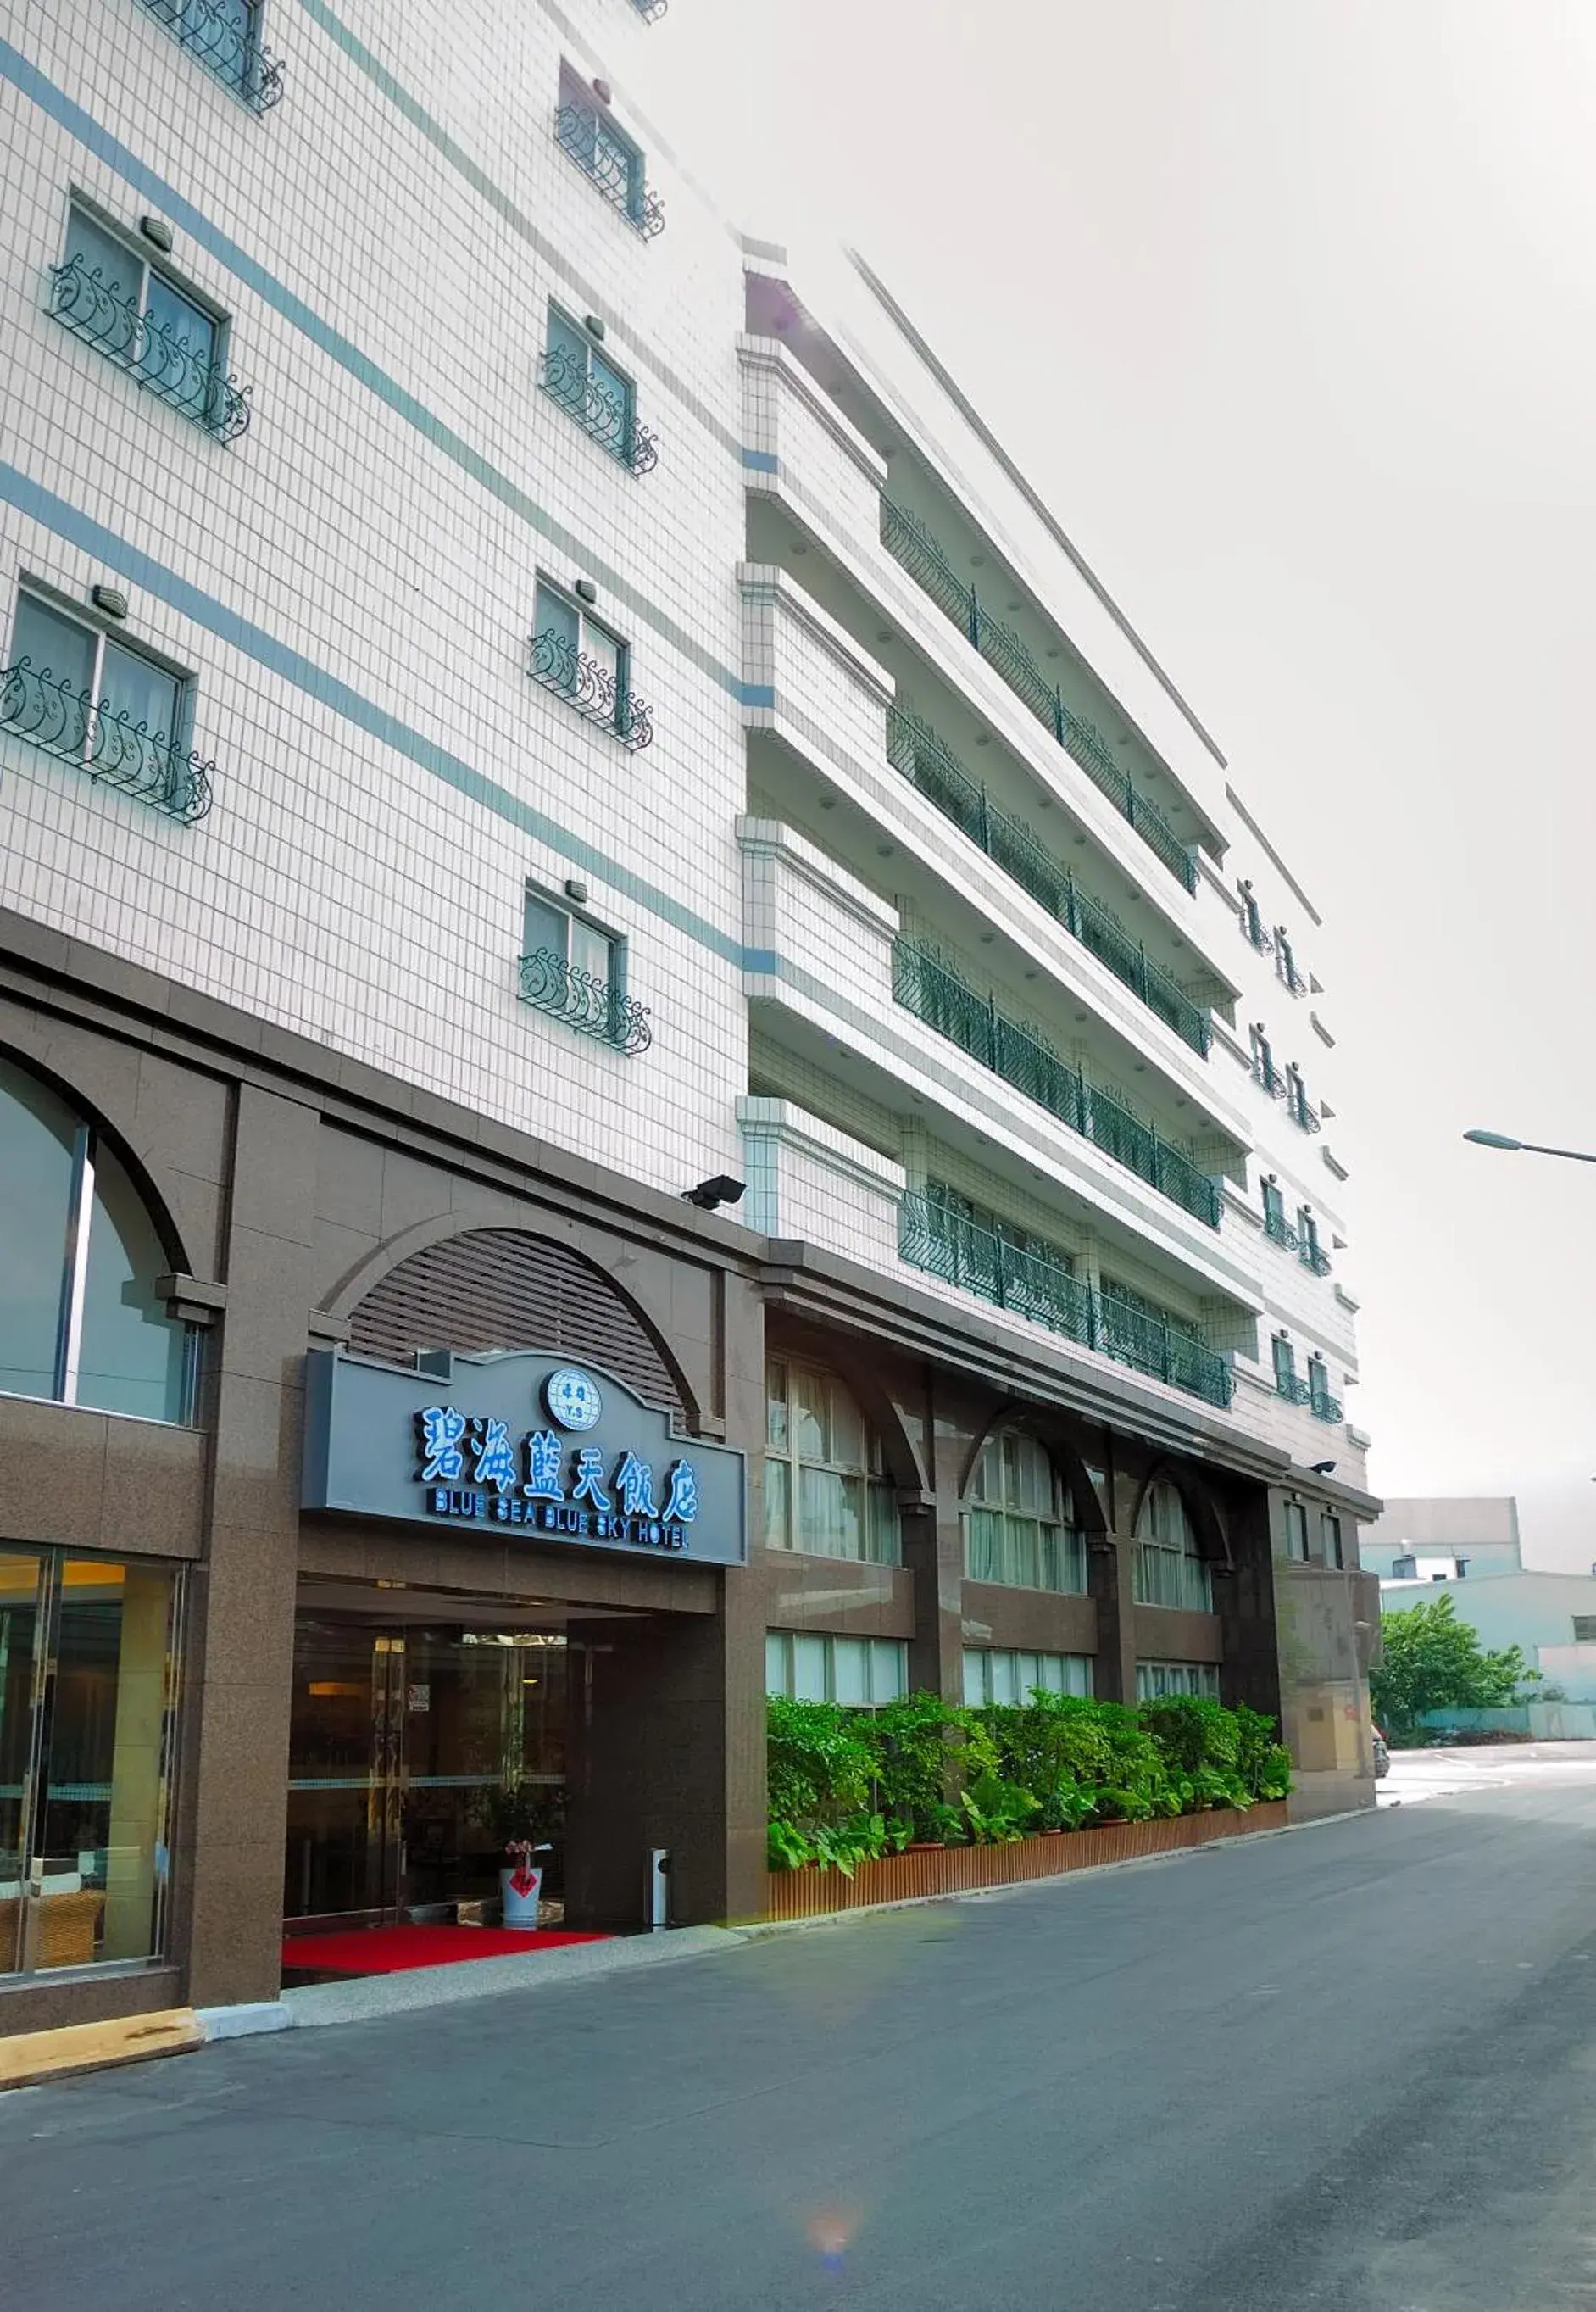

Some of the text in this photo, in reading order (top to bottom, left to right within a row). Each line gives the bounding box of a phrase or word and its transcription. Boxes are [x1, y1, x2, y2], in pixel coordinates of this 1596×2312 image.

[422, 1405, 698, 1524] 碧海藍天飯店
[435, 1488, 690, 1549] BLUE SEA BLUE SKY HOTEL
